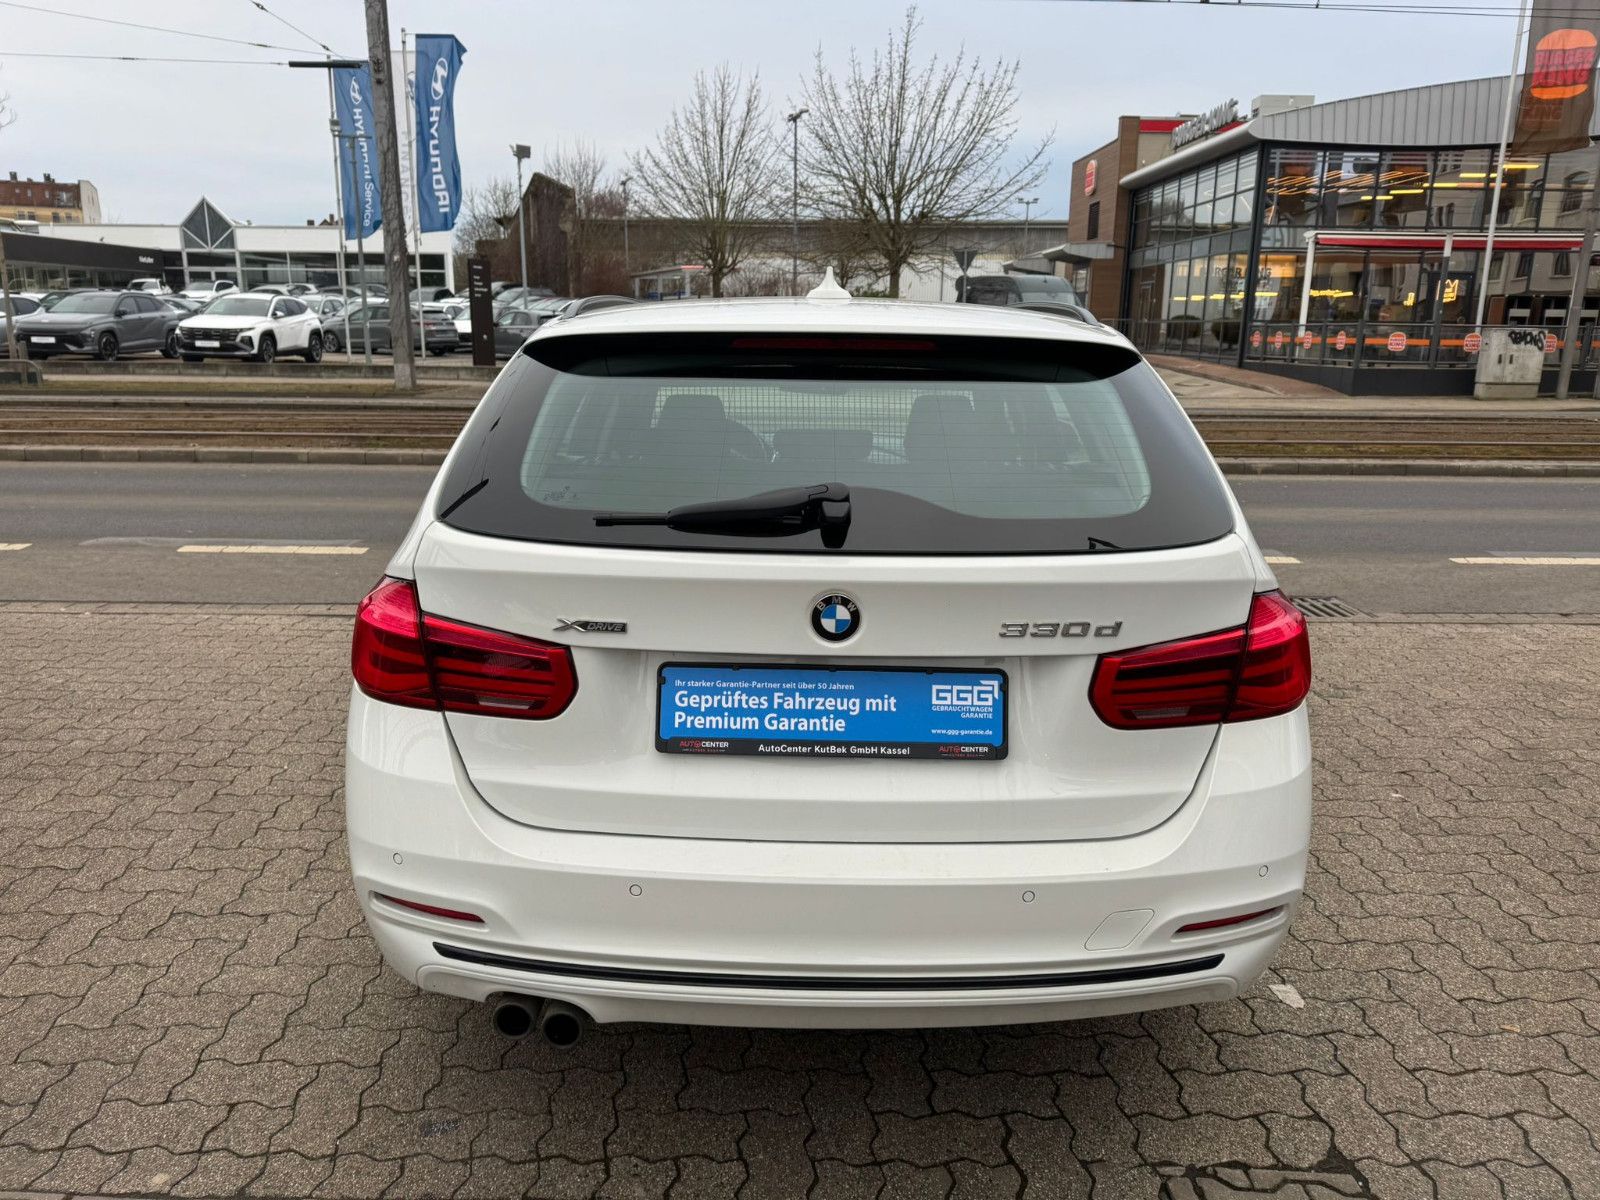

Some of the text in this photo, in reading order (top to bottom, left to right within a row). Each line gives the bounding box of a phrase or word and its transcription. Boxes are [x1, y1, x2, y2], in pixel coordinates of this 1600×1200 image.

[429, 106, 450, 213] HYUNDAI
[362, 182, 375, 227] Service
[998, 621, 1123, 638] 330d
[687, 680, 714, 688] starker
[716, 681, 780, 689] Garantie-Partner
[797, 682, 815, 690] über
[932, 684, 993, 706] GGG
[674, 690, 897, 715] Geprüftes Fahrzeug mit
[931, 705, 993, 713] GEBRAUCHTWAGEN
[674, 711, 846, 732] Premium Garantie
[758, 744, 910, 755] AutoCenter KutBek GmbH Kassel
